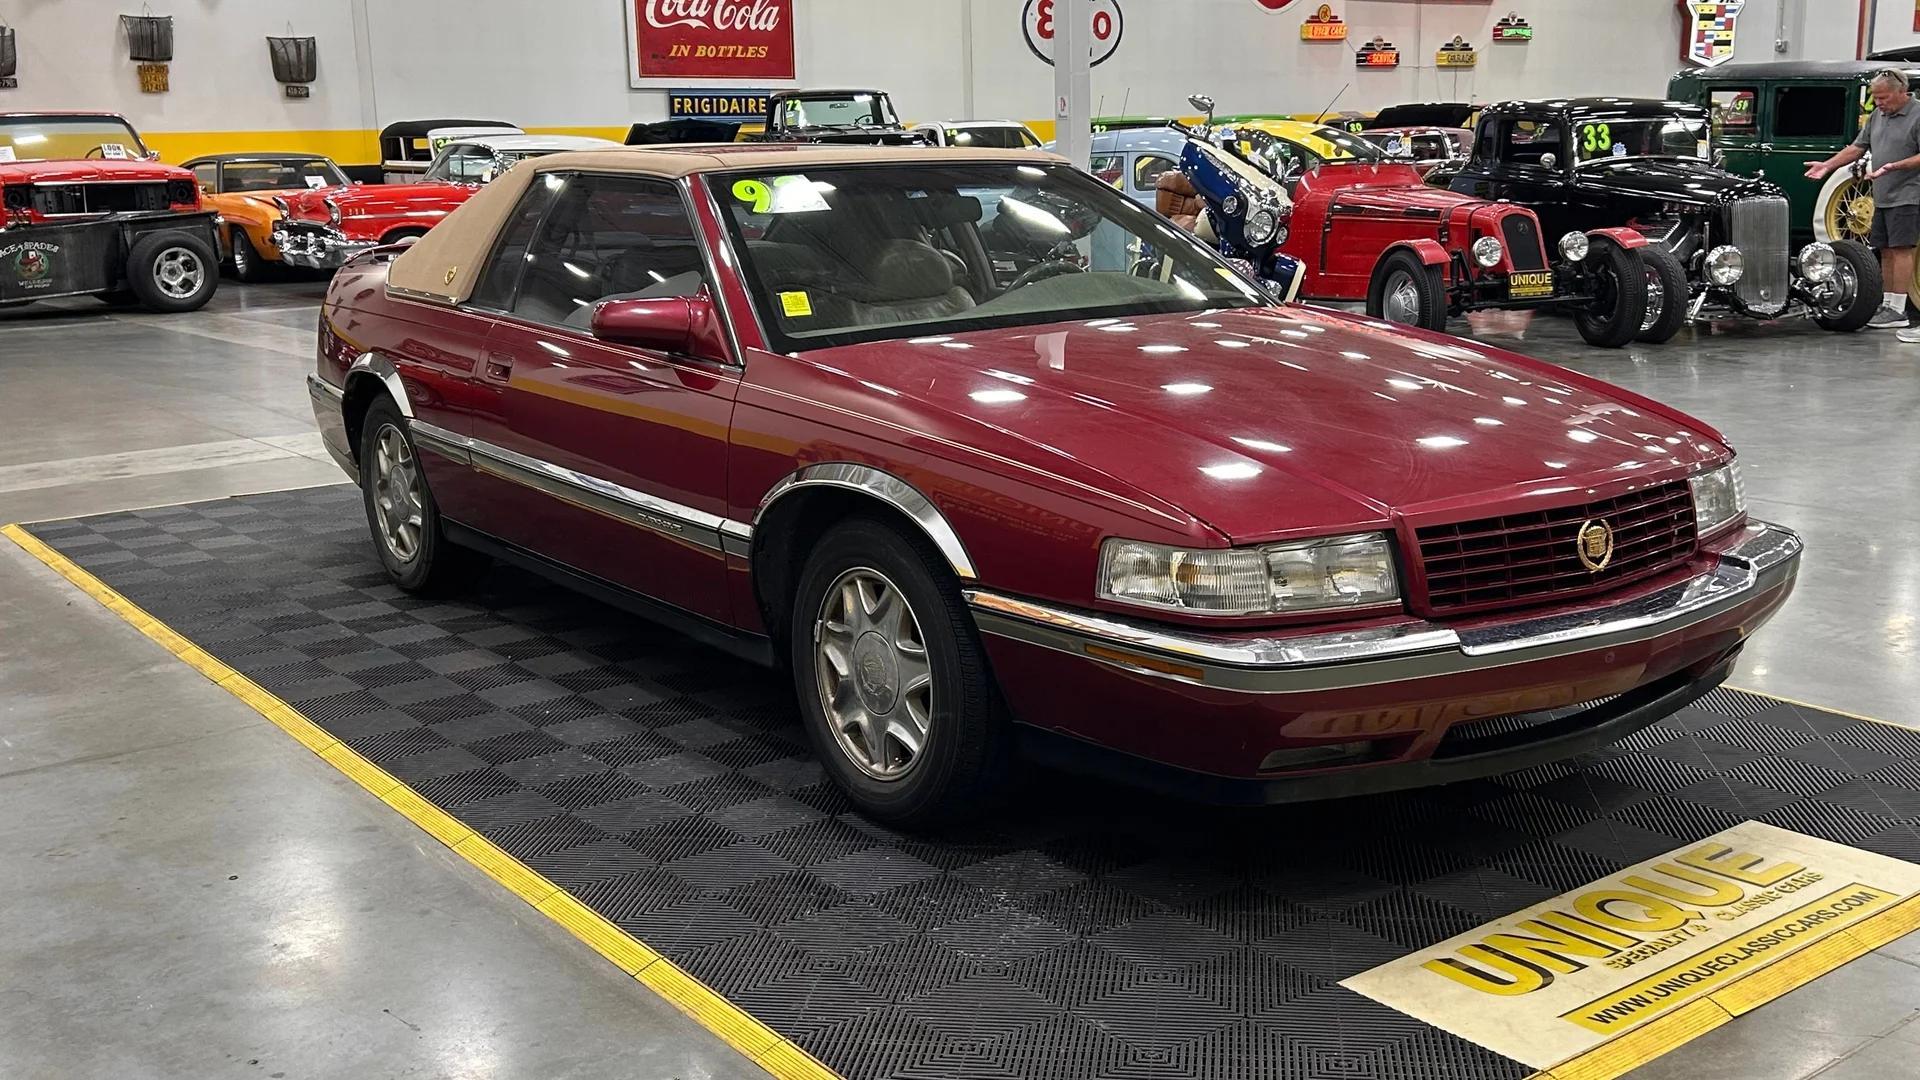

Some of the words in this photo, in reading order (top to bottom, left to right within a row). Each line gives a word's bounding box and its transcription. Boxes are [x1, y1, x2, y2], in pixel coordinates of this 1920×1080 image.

[714, 0, 779, 31] Cola
[669, 45, 691, 57] IN
[695, 45, 769, 58] BOTTLES
[673, 98, 767, 114] FRIGIDAIRE
[1583, 123, 1612, 152] 33
[1510, 273, 1552, 286] UNIQUE
[1420, 842, 1807, 996] UNIQUE
[1714, 888, 1783, 921] CLASSIC
[1587, 891, 1878, 1025] WWW.UNIQUECLASSICCARS.COM
